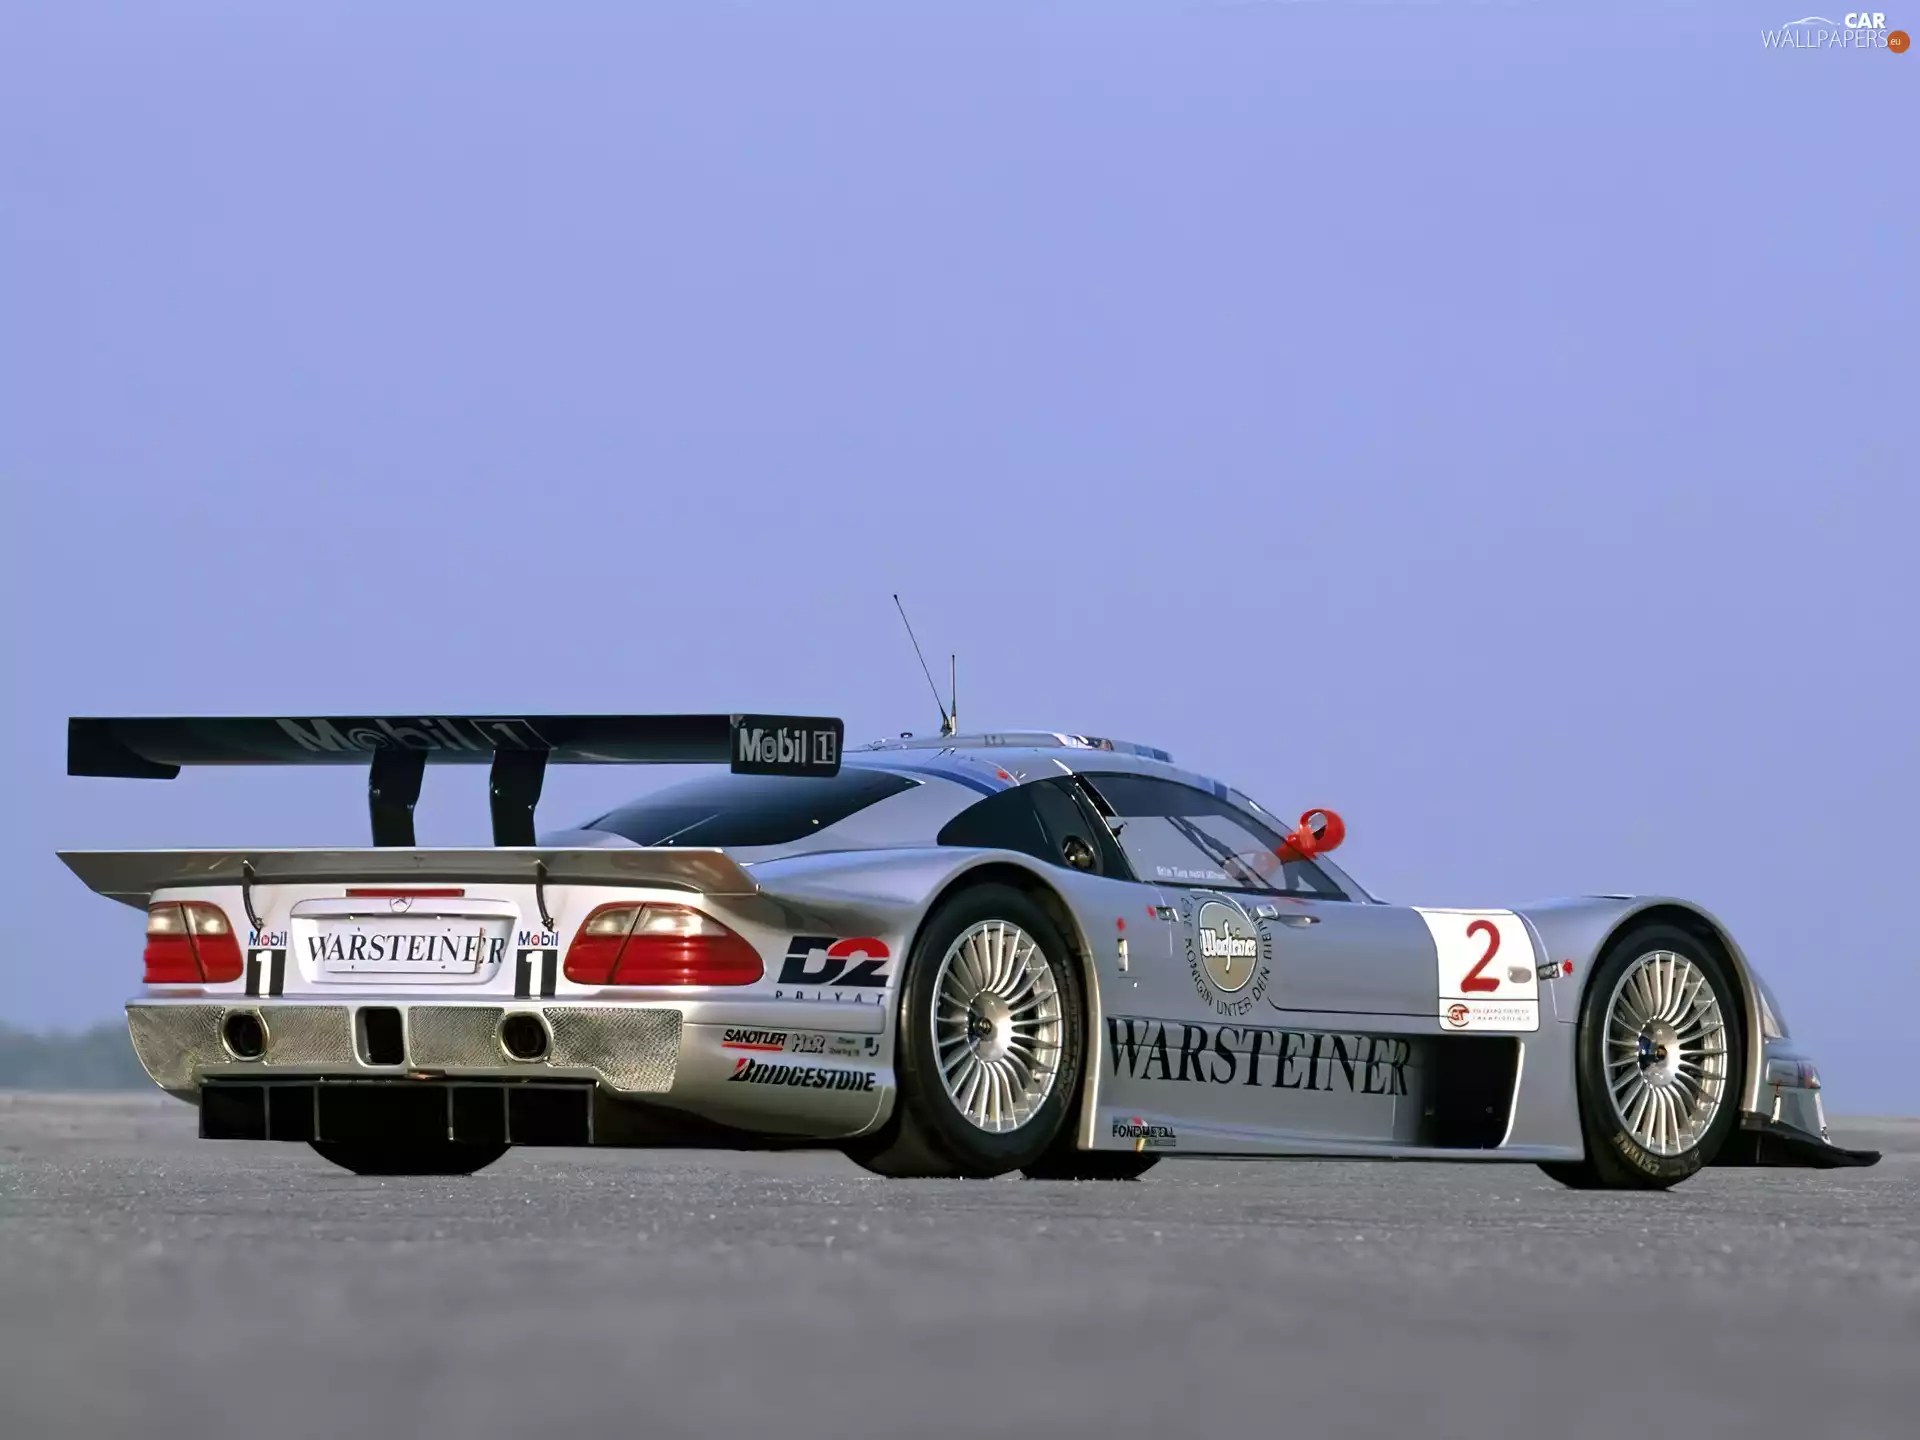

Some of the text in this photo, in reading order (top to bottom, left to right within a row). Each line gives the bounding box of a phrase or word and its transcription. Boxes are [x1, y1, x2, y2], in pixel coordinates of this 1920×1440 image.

[275, 718, 484, 751] Mobil
[739, 727, 807, 763] Mobil
[248, 931, 288, 947] Mobil
[307, 932, 506, 965] WARSTEINER
[518, 931, 559, 947] Mobil
[1460, 919, 1501, 993] 2
[255, 950, 273, 998] 1
[525, 950, 542, 998] 1
[777, 935, 890, 988] D2
[1106, 1016, 1412, 1097] WARSTEINER
[728, 1057, 878, 1093] BRIDGESTONE
